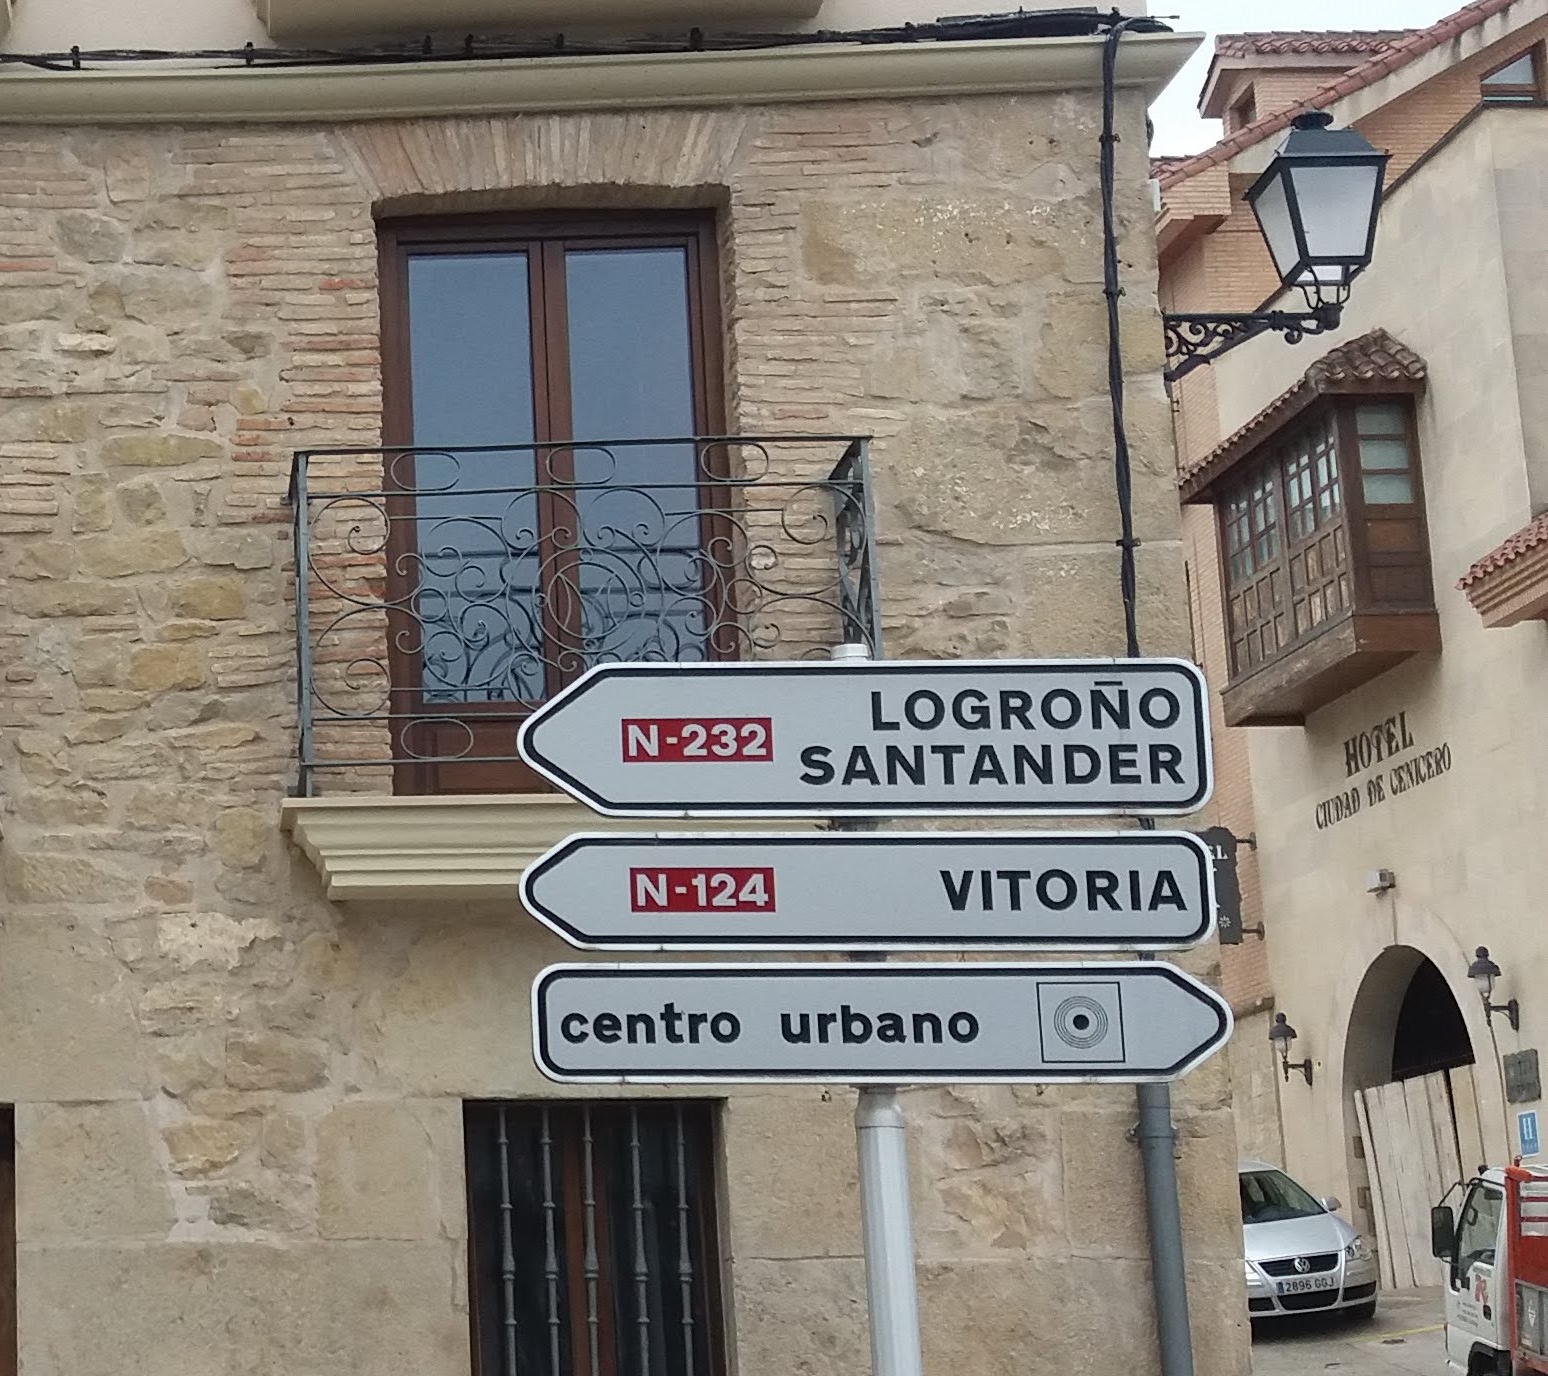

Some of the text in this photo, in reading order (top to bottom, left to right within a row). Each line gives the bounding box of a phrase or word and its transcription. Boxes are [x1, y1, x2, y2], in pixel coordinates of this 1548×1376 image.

[870, 680, 1182, 731] LOGROÑO
[626, 723, 768, 757] N-232
[1343, 710, 1415, 778] HOTEL
[798, 742, 1186, 787] SANTANDER
[1315, 742, 1452, 830] CIUDAD DE CENICERO
[636, 873, 769, 907] N-124
[939, 868, 1188, 912] VITORIA
[560, 1002, 981, 1045] centro urbano
[1285, 1279, 1312, 1292] 2896
